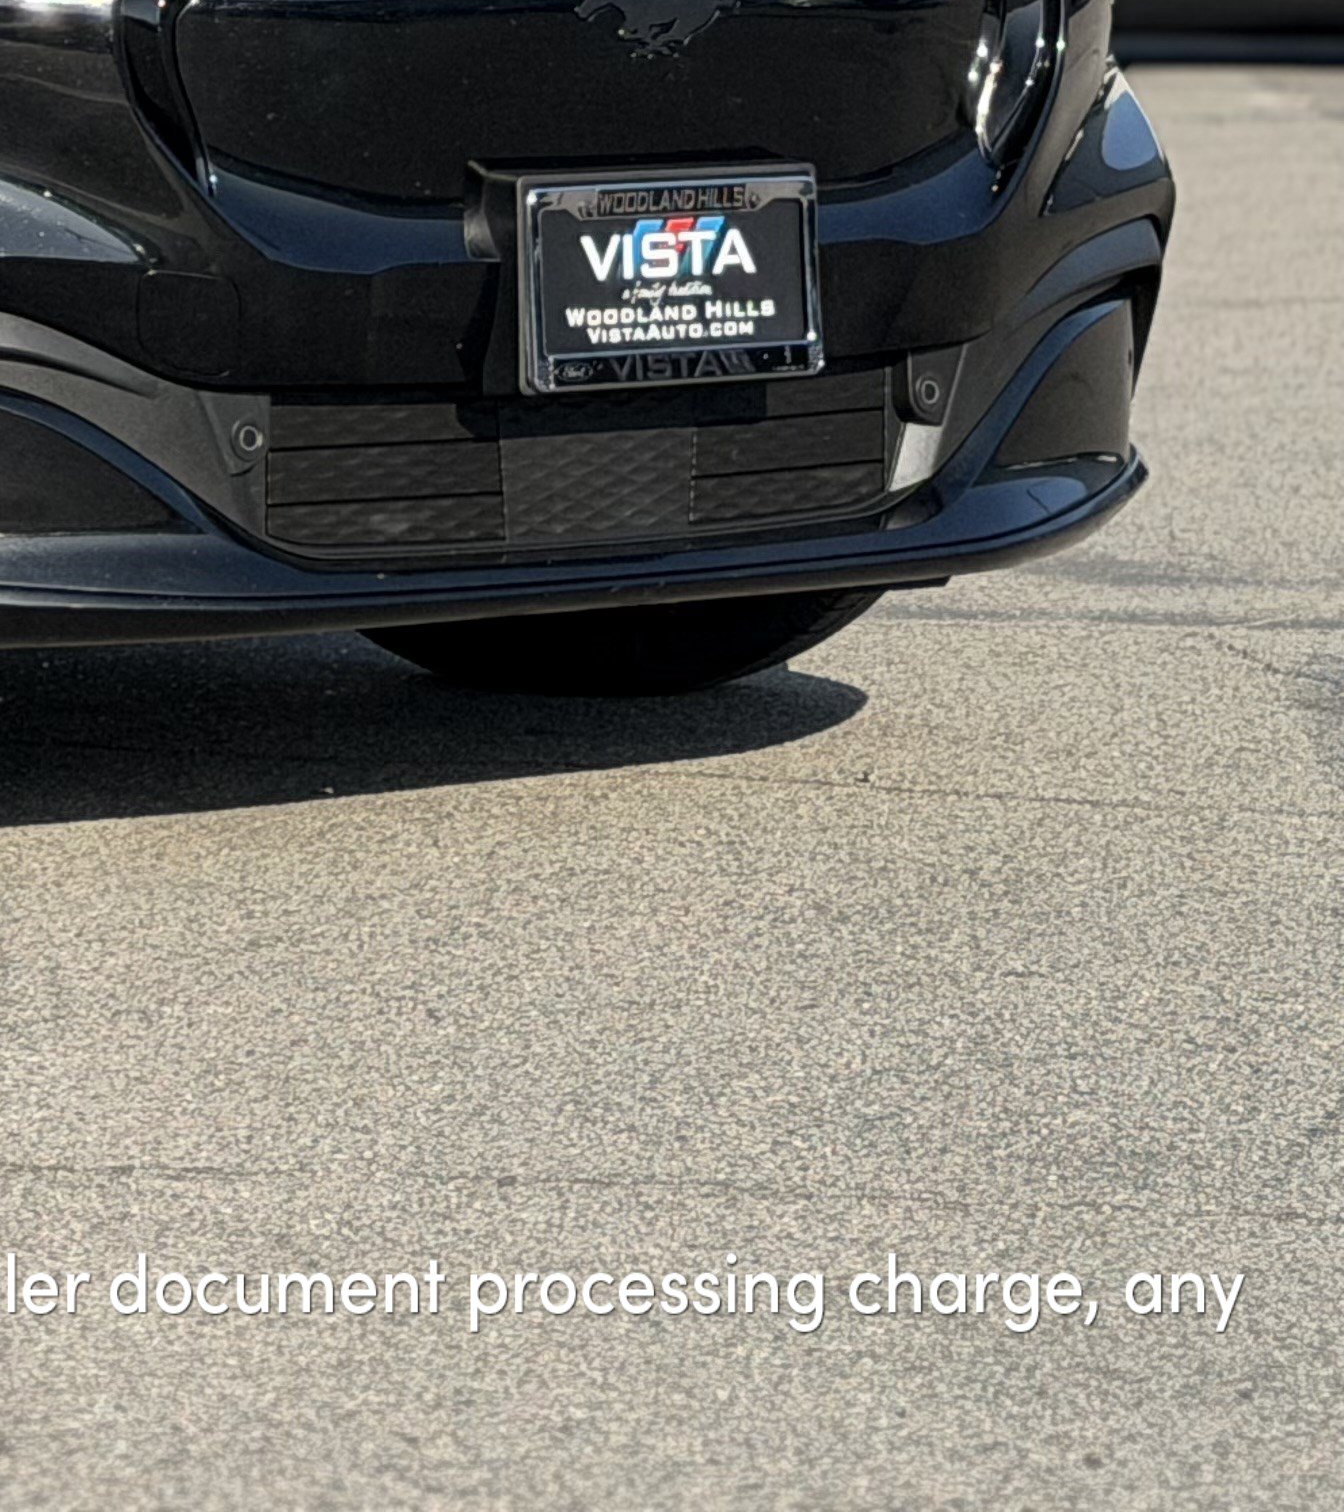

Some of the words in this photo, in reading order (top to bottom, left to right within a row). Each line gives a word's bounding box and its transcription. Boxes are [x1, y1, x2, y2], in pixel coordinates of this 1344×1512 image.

[598, 189, 696, 215] WOODLAND
[697, 186, 745, 208] HILLS
[579, 227, 757, 282] VISTA
[565, 303, 698, 328] WOODLAND
[704, 298, 776, 320] HILLS
[609, 351, 724, 381] VISTA
